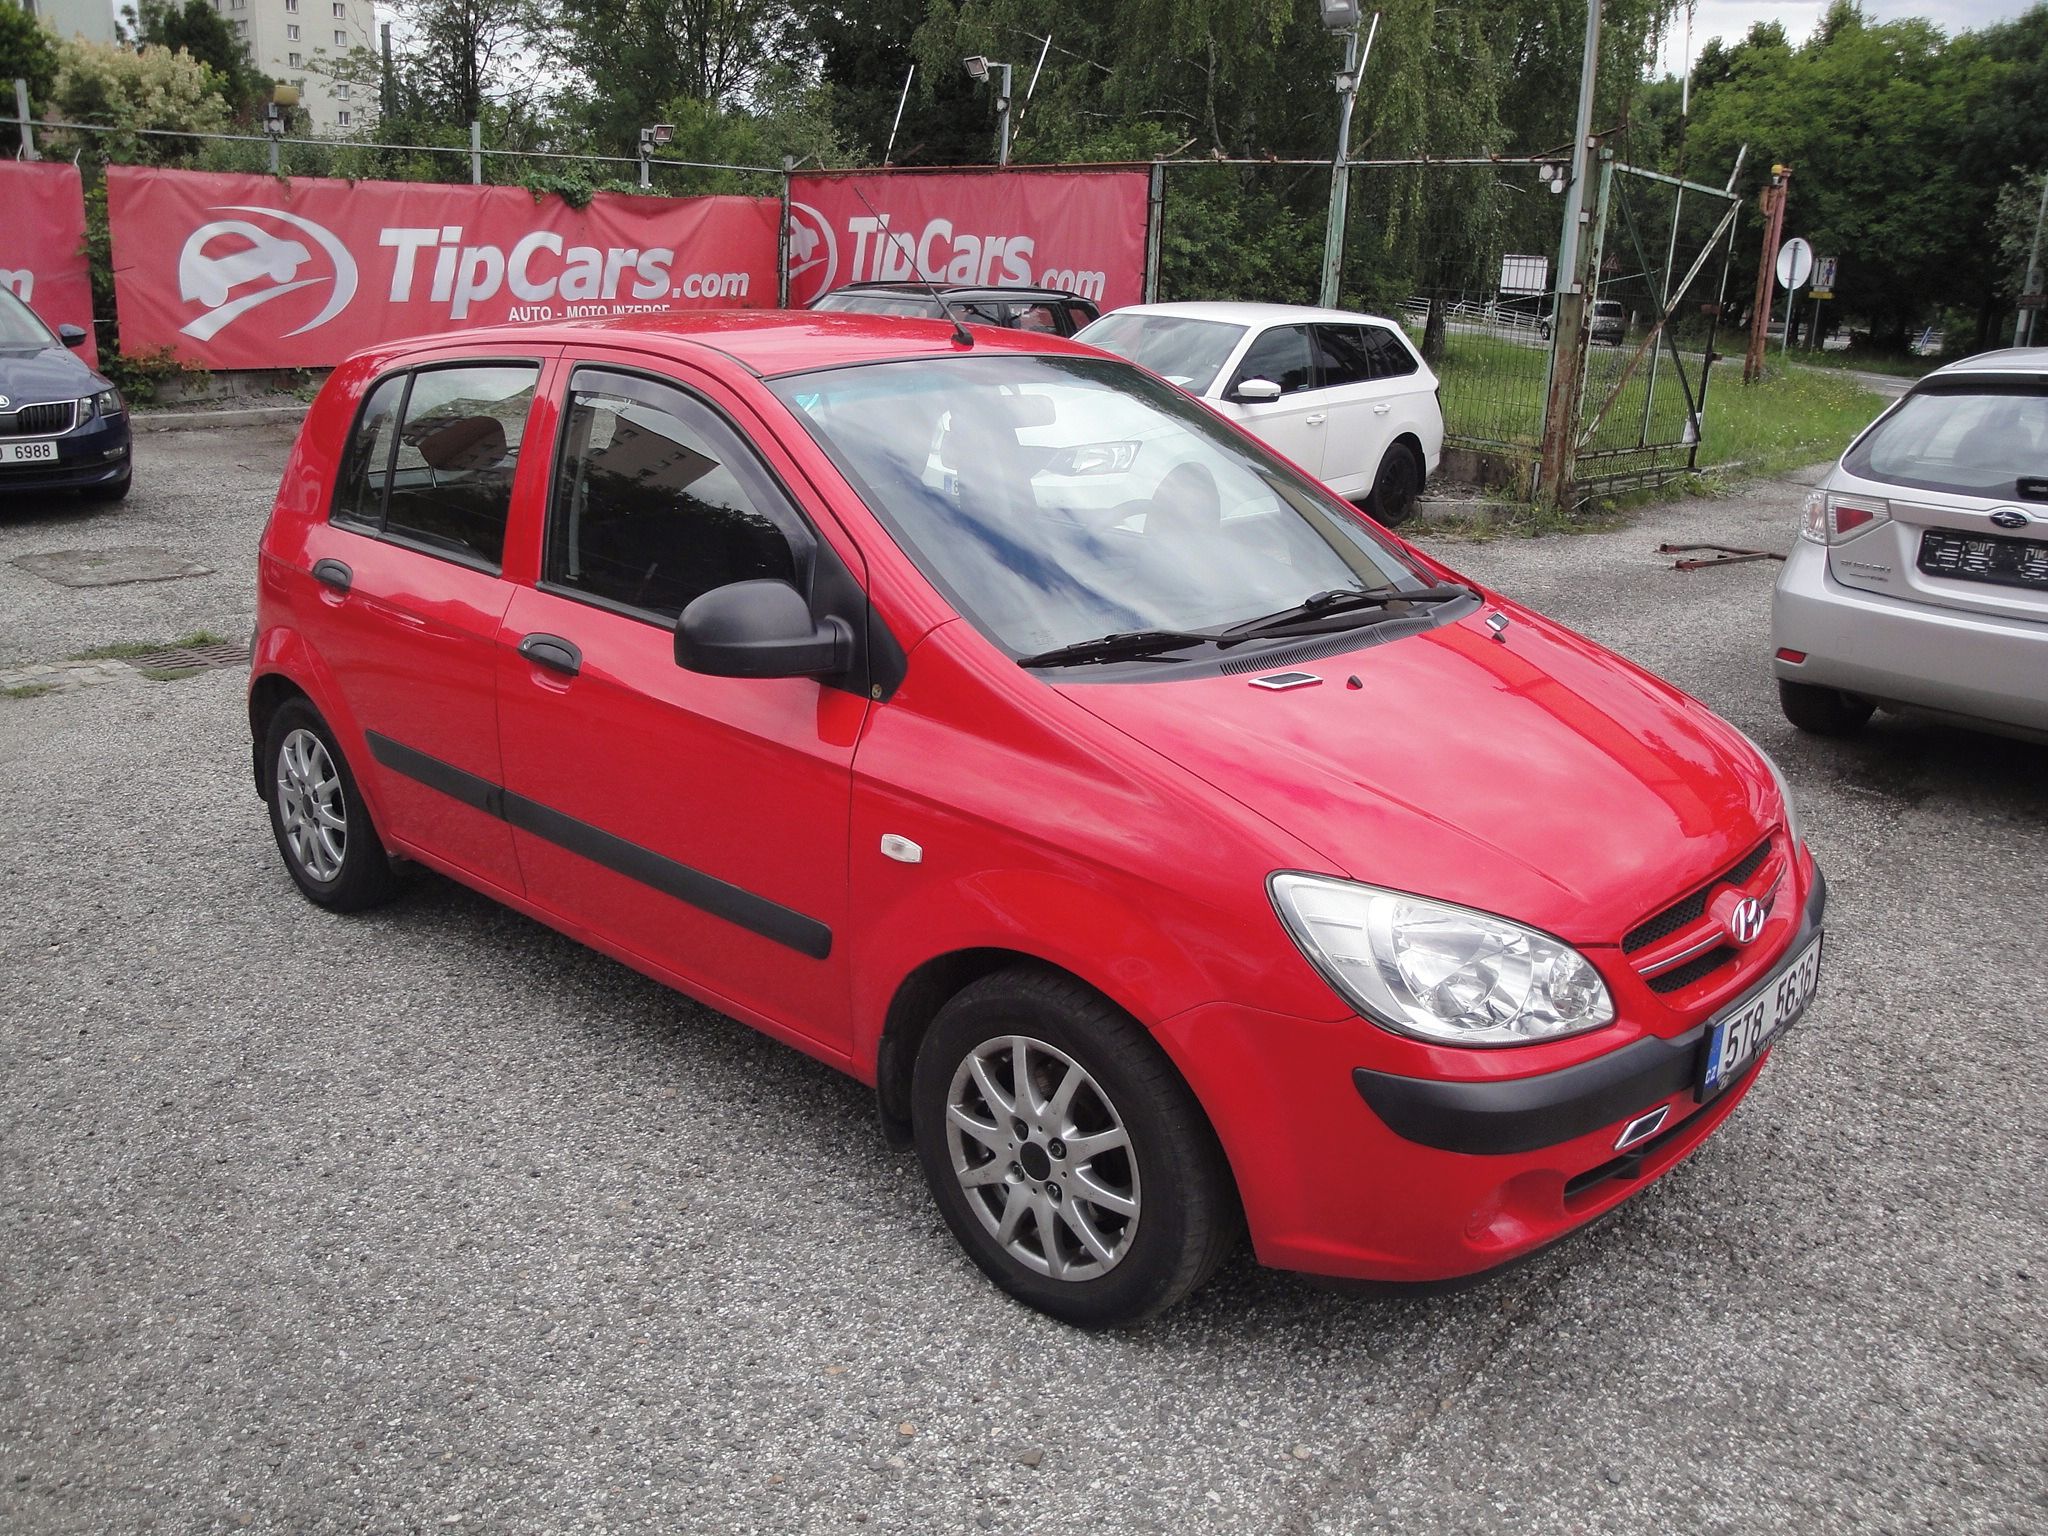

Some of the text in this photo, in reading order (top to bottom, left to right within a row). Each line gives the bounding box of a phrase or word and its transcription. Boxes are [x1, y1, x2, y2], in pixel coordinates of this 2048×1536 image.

[378, 225, 751, 320] TipCars.com
[508, 306, 551, 321] AUTO
[566, 305, 608, 319] MOTO
[14, 444, 51, 459] 6988
[1725, 1001, 1764, 1069] 5T8
